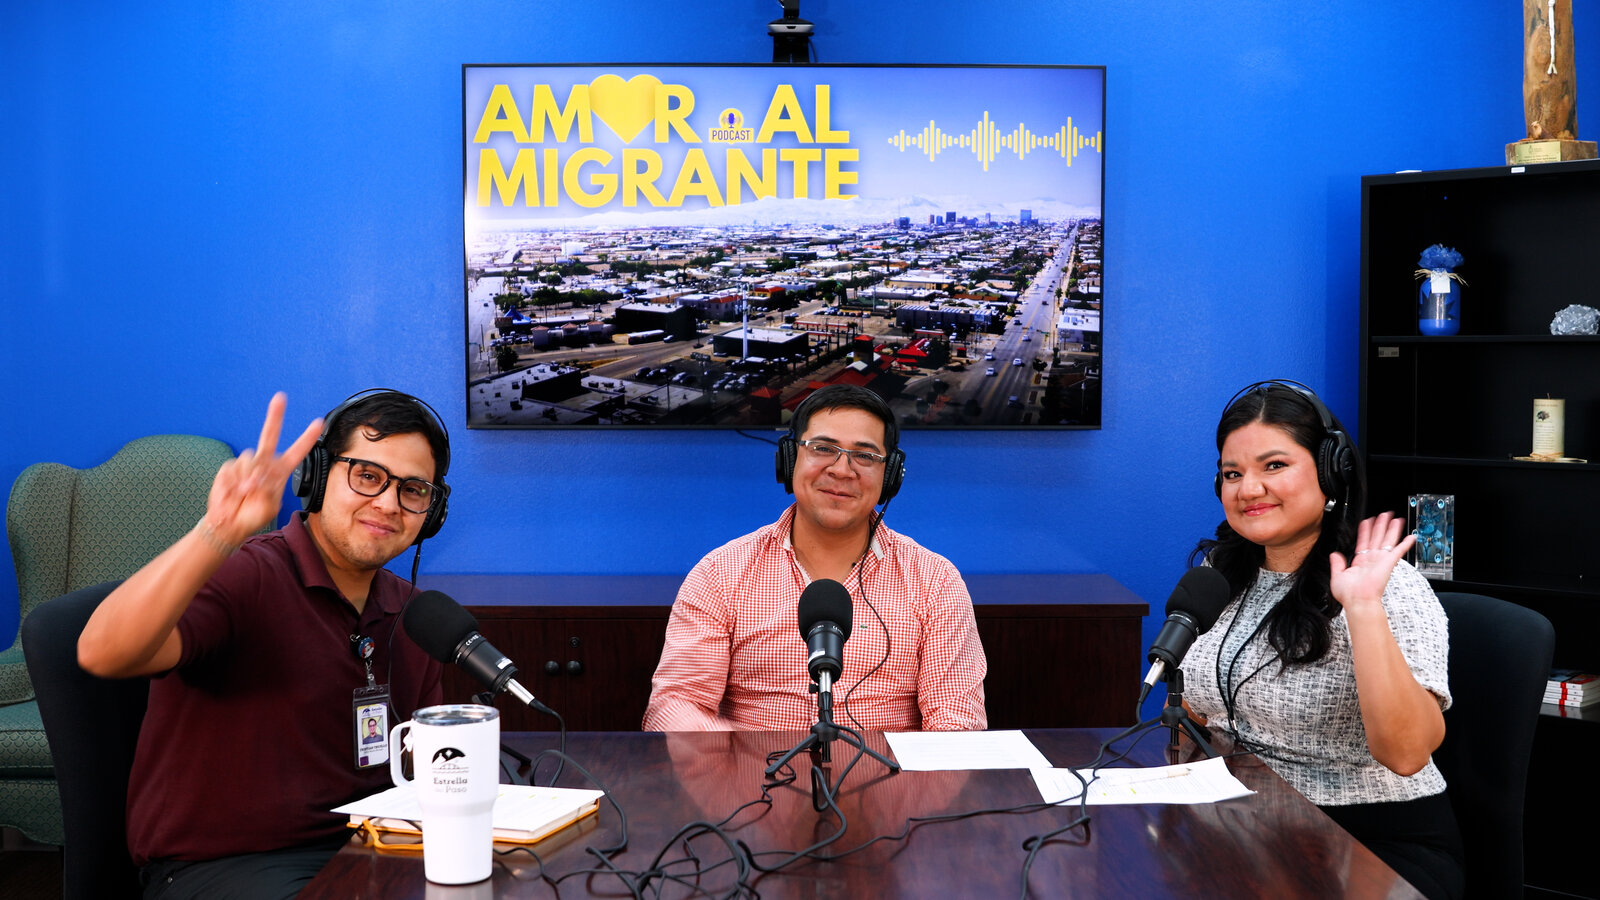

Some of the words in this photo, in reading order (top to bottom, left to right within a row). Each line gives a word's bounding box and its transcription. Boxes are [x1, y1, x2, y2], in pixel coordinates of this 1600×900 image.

[755, 84, 850, 143] AL
[712, 130, 751, 141] PODCAST
[477, 147, 859, 207] MIGRANTE
[433, 777, 468, 785] Estrella
